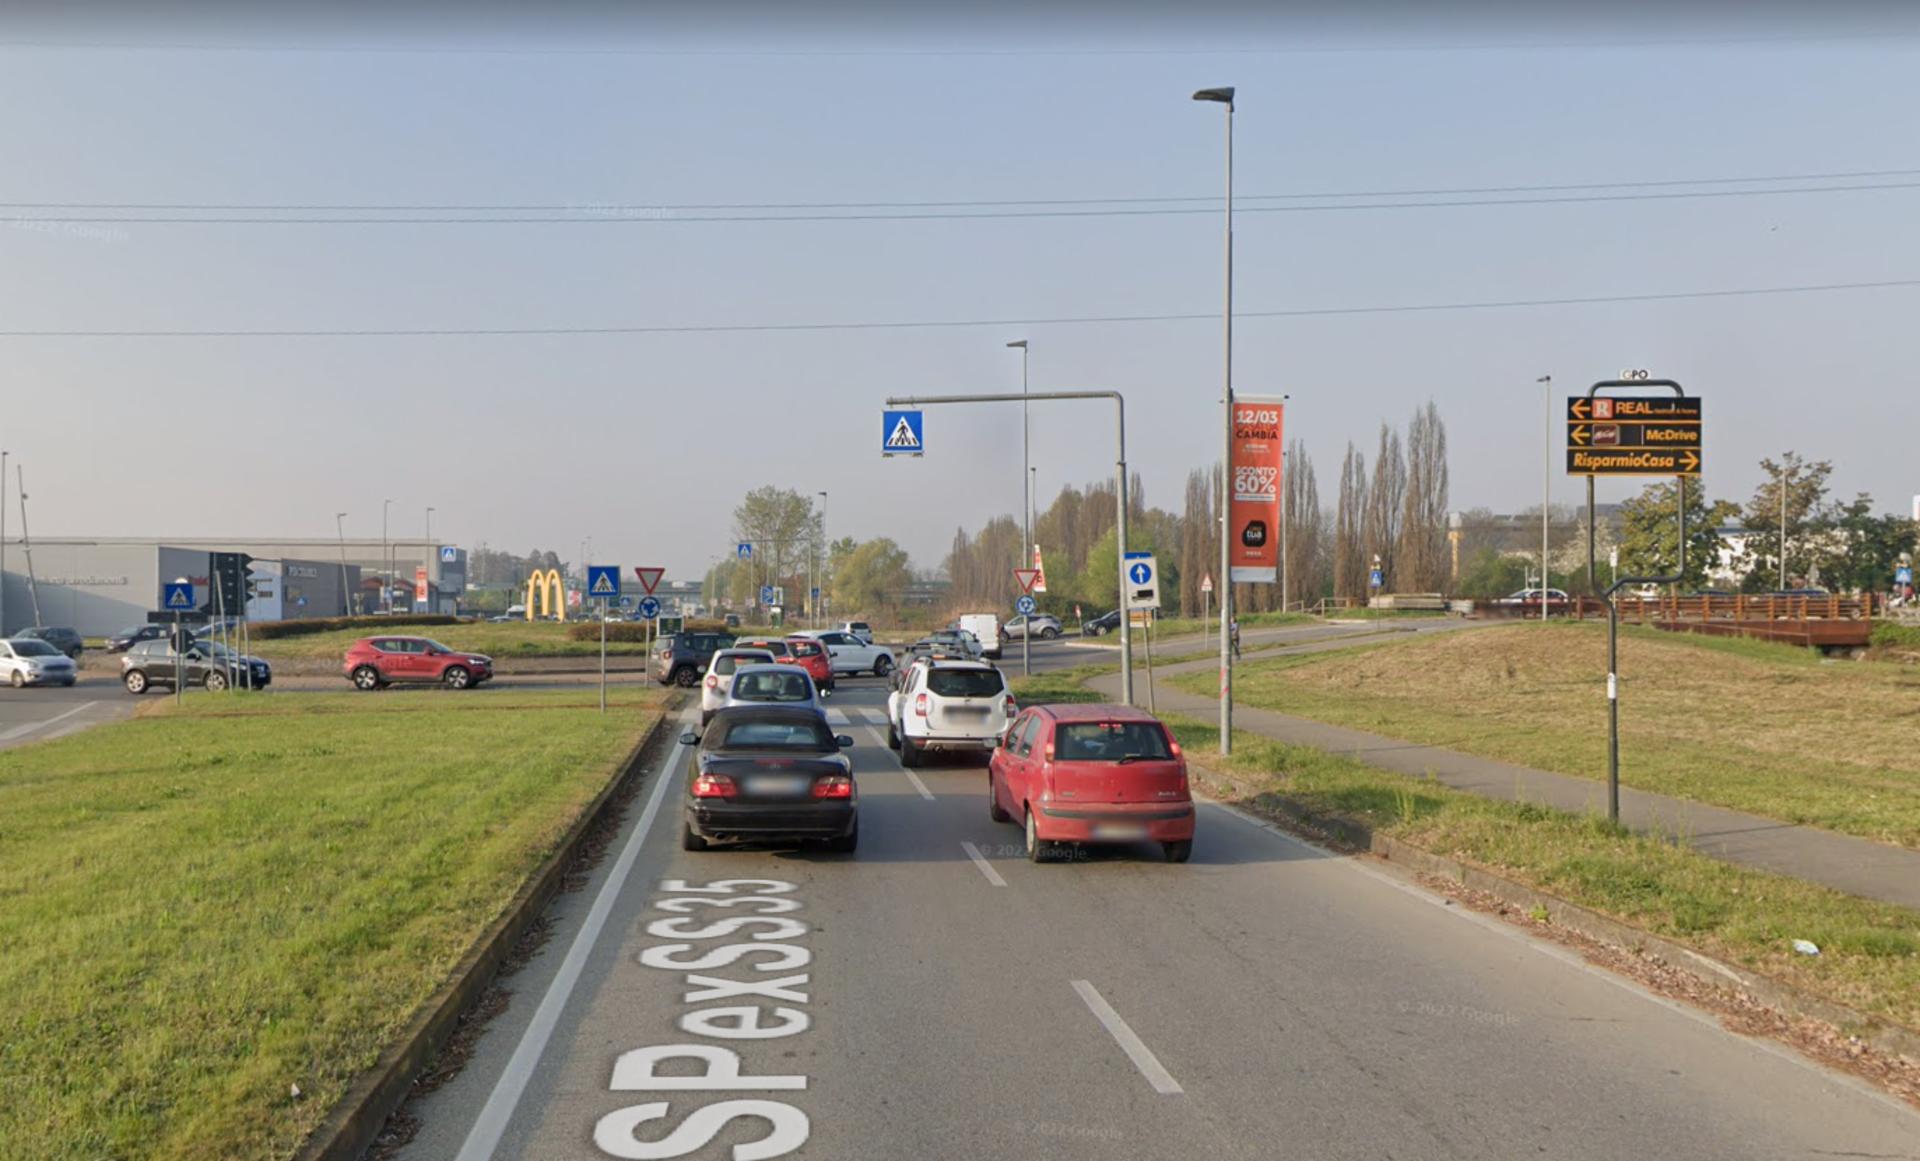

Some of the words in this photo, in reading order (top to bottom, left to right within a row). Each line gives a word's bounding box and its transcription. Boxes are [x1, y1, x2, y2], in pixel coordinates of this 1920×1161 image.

[1615, 402, 1654, 414] REAL
[1236, 410, 1278, 425] 12/03
[1235, 429, 1278, 441] CAMBIA
[1645, 429, 1698, 441] McDrive
[1573, 451, 1675, 470] RisparmioCasa
[1235, 466, 1277, 476] SCONTO
[1234, 475, 1276, 493] 60%
